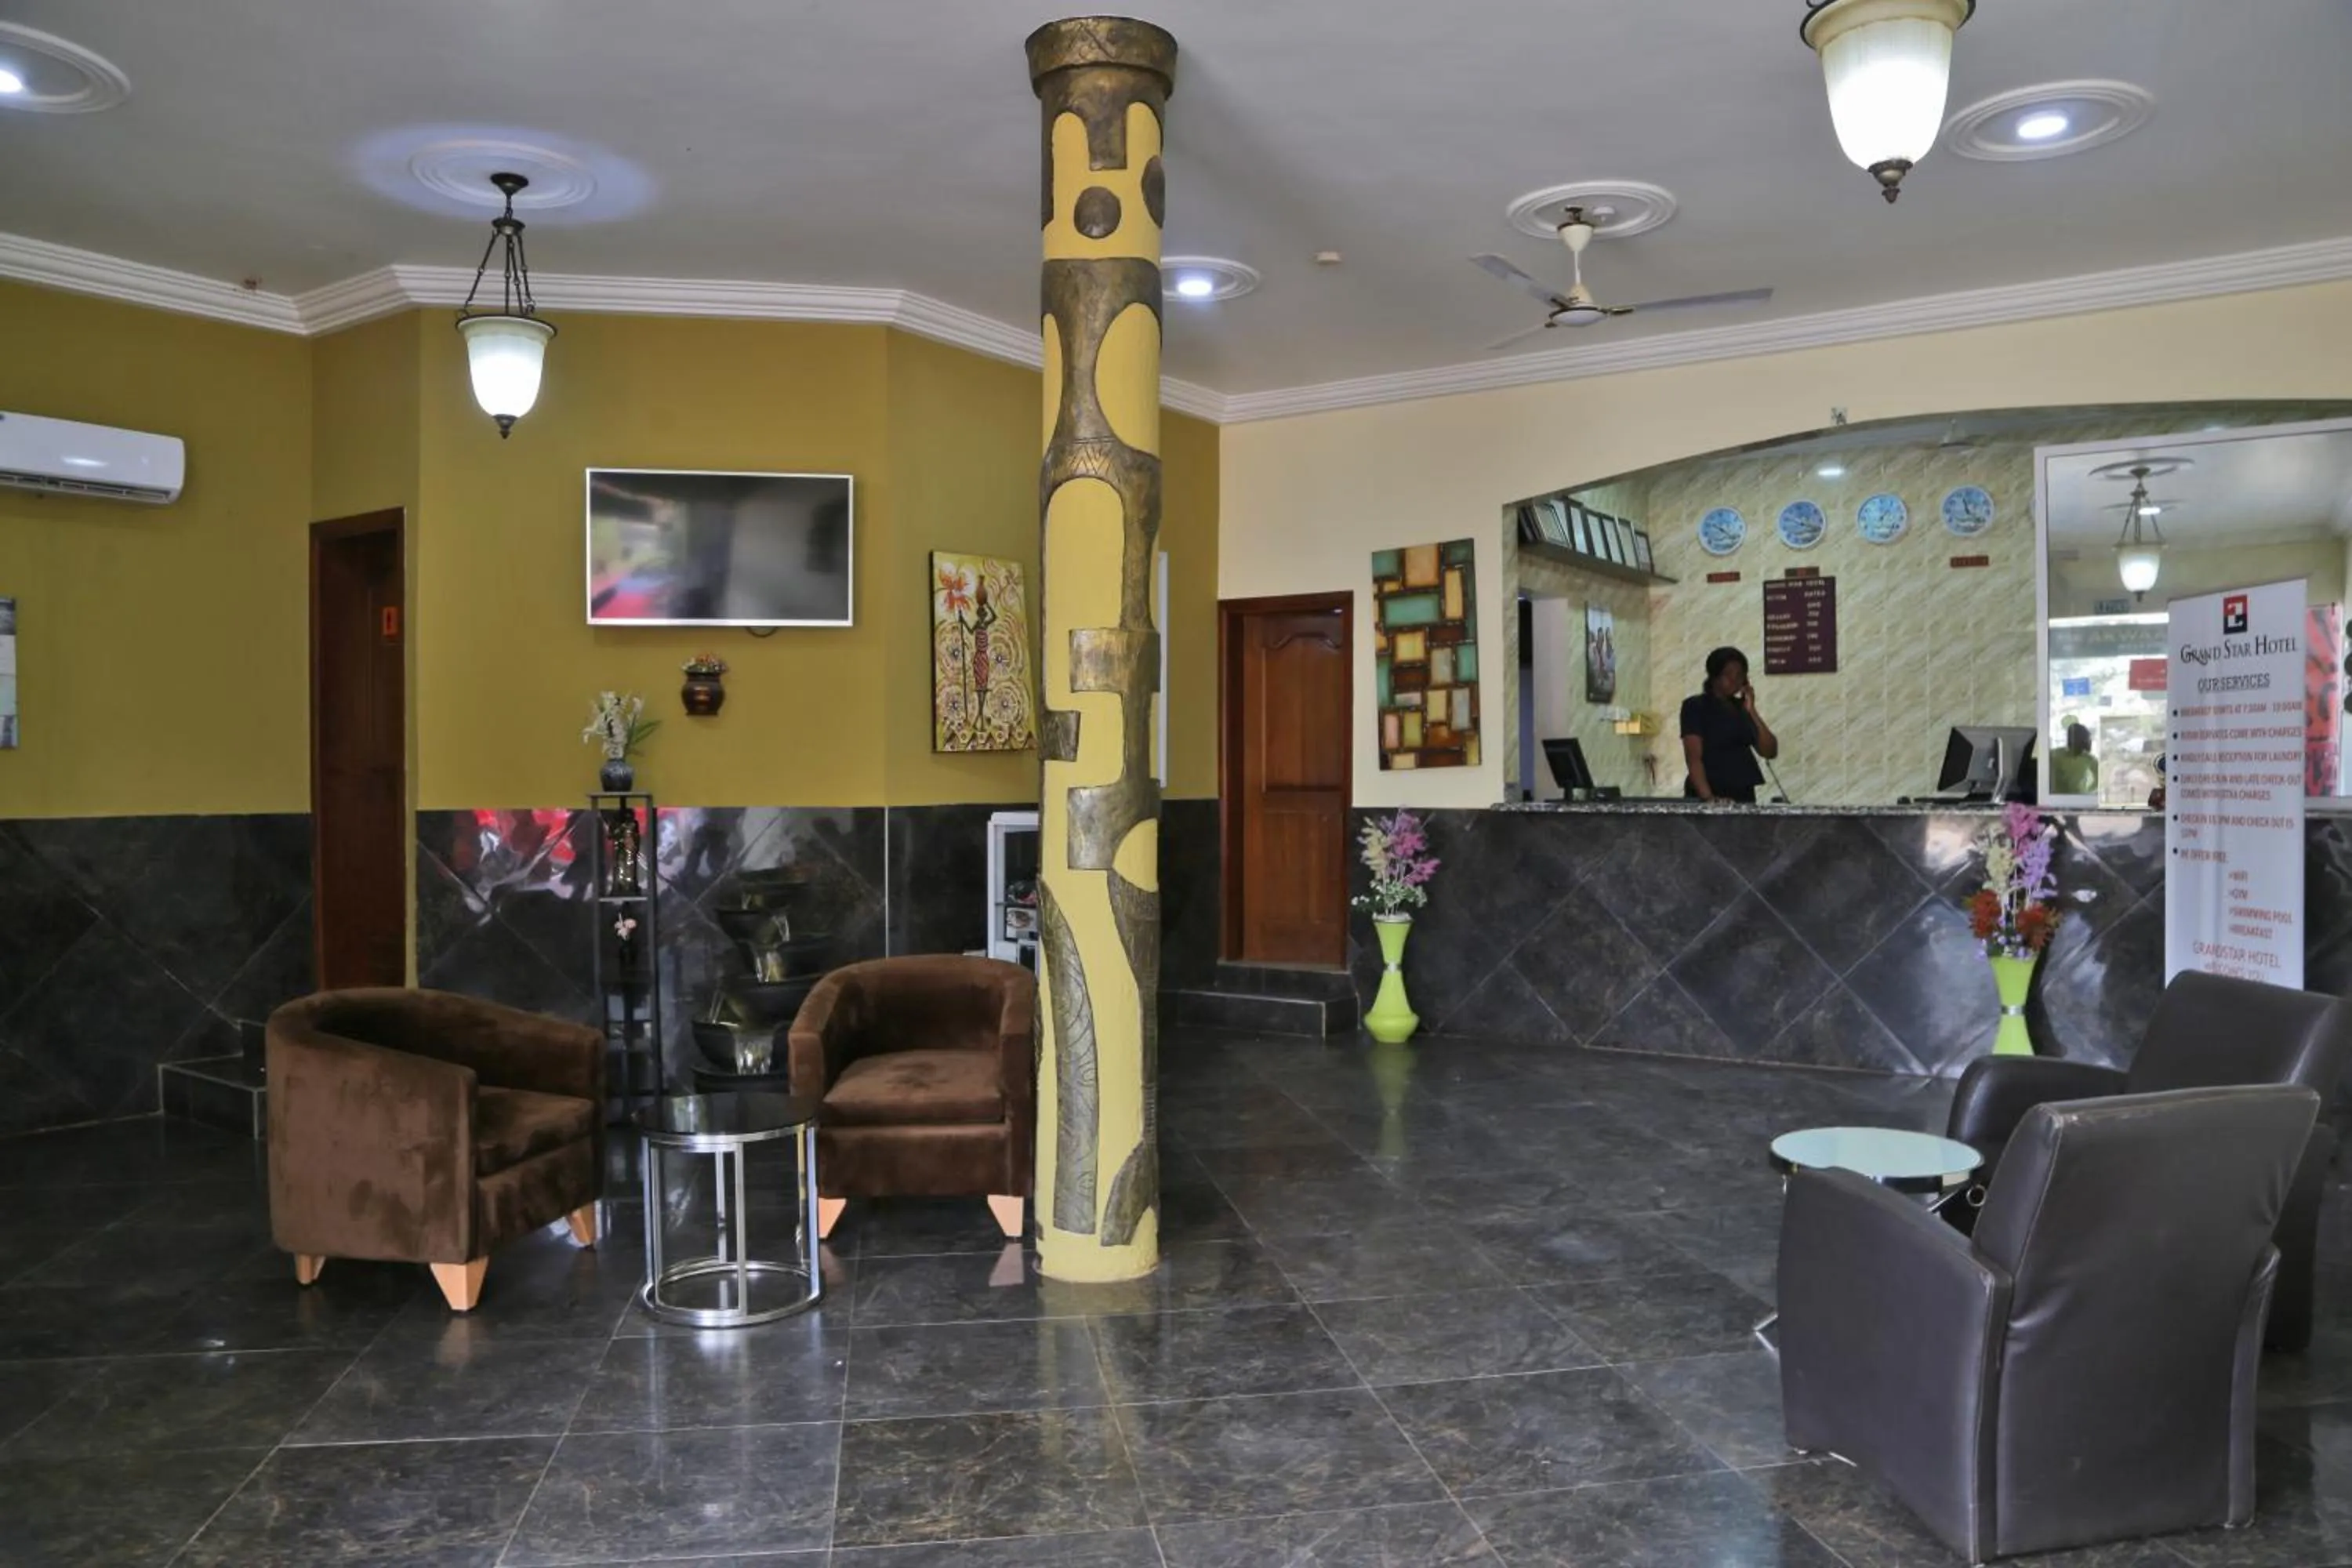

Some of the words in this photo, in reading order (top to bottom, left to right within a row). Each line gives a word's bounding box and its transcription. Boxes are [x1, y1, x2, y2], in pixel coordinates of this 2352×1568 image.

[2180, 643, 2222, 666] GRAND
[2223, 637, 2252, 659] STAR
[2256, 633, 2299, 655] HOTEL
[2198, 677, 2220, 694] OUR
[2220, 672, 2270, 691] SERVICES
[2248, 949, 2281, 968] HOTEL
